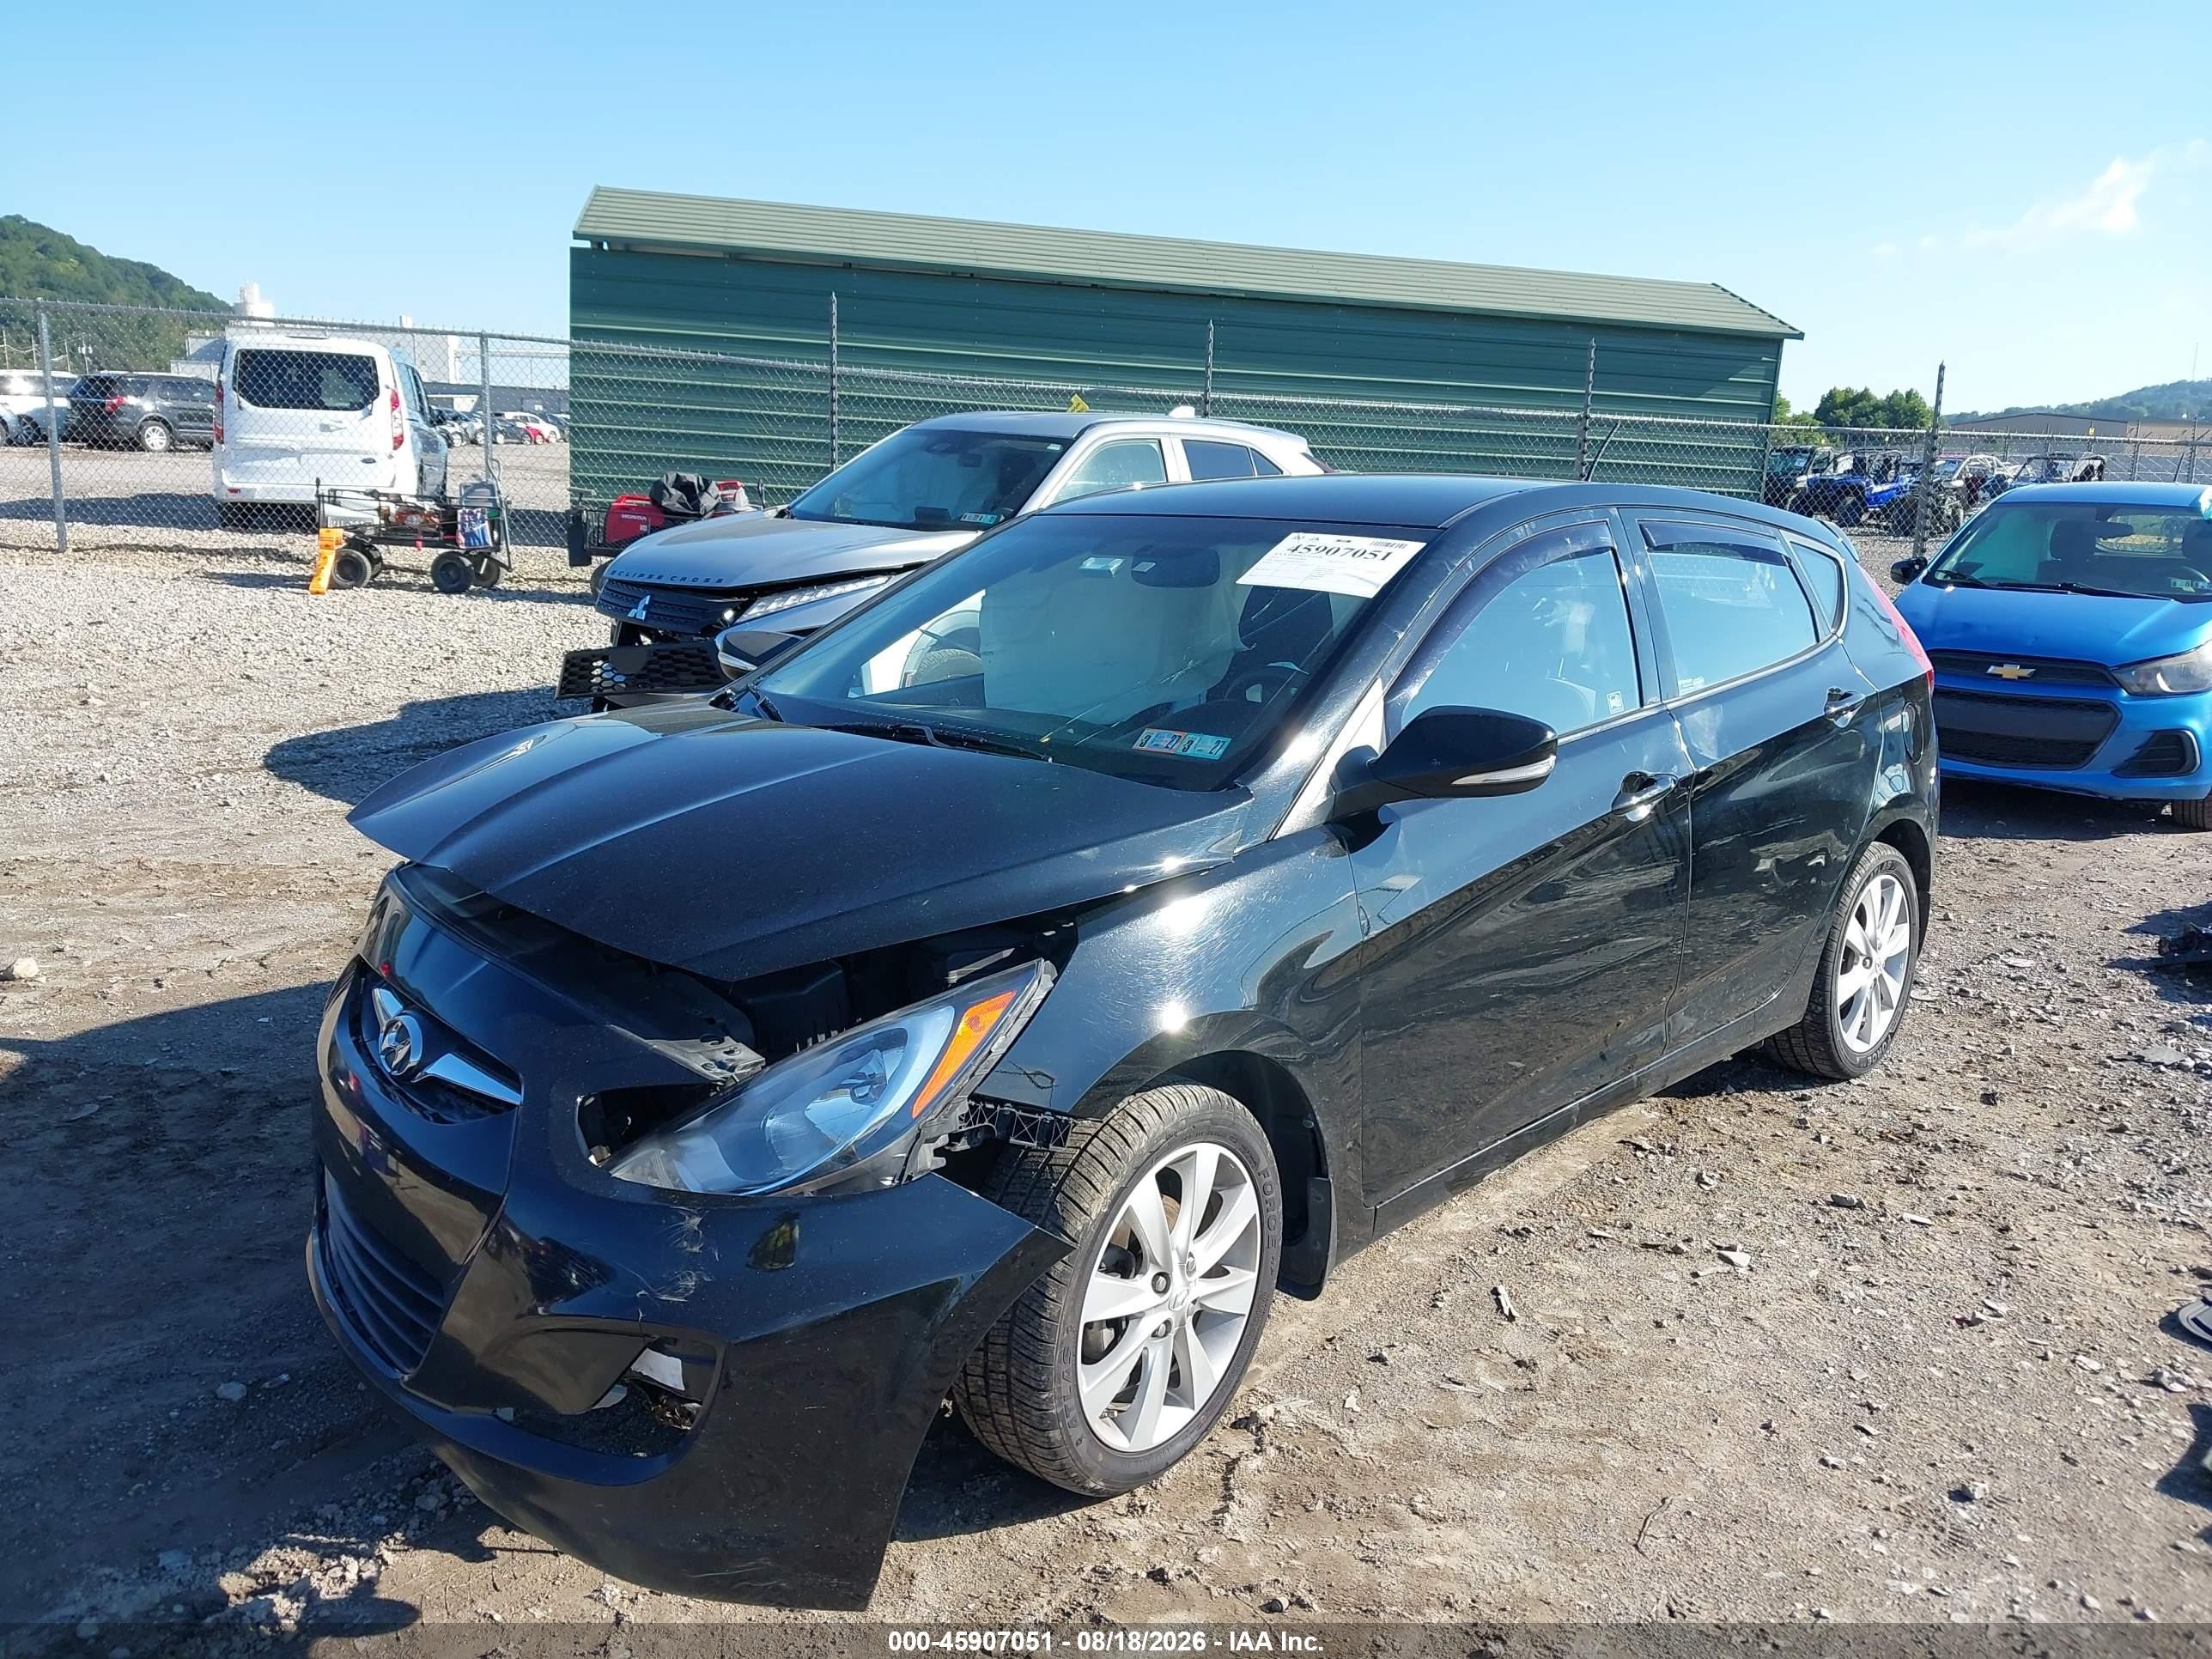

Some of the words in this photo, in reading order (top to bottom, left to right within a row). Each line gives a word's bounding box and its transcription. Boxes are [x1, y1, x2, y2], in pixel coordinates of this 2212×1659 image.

[1287, 544, 1393, 561] 45907051
[611, 569, 664, 580] ECLIPSE
[670, 575, 724, 584] CROSS
[1139, 735, 1152, 748] 3
[1165, 734, 1182, 750] 27
[1182, 739, 1194, 753] 3
[1209, 740, 1226, 756] 27
